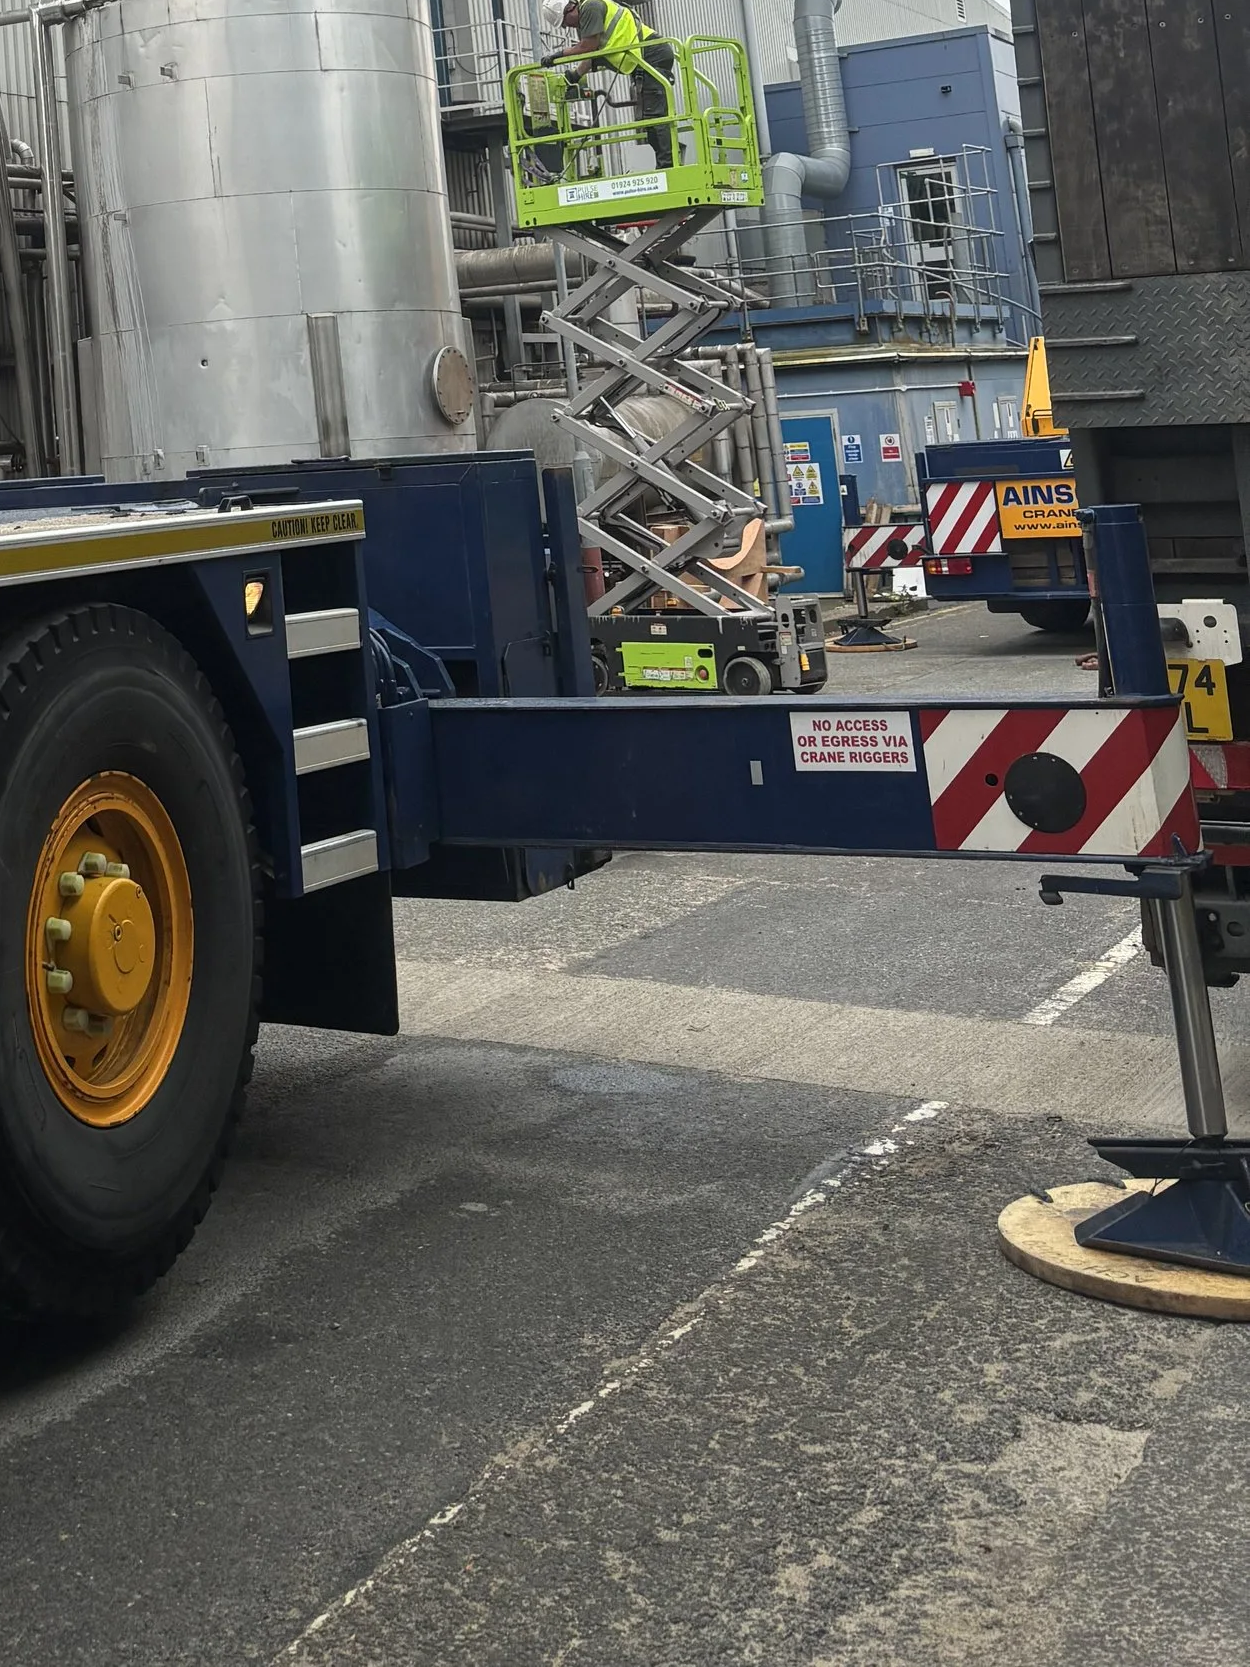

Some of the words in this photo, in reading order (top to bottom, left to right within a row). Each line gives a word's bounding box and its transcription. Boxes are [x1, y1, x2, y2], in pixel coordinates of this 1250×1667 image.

[577, 184, 598, 194] PULSE
[611, 180, 631, 190] 01924
[271, 516, 308, 539] CAUTION!
[310, 514, 330, 533] KEEP
[812, 720, 832, 732] NO
[835, 719, 888, 732] ACCESS
[797, 735, 817, 747] OR
[821, 735, 878, 747] EGRESS
[882, 735, 908, 747] VIA
[800, 751, 845, 763] CRANE
[849, 751, 909, 764] RIGGERS
